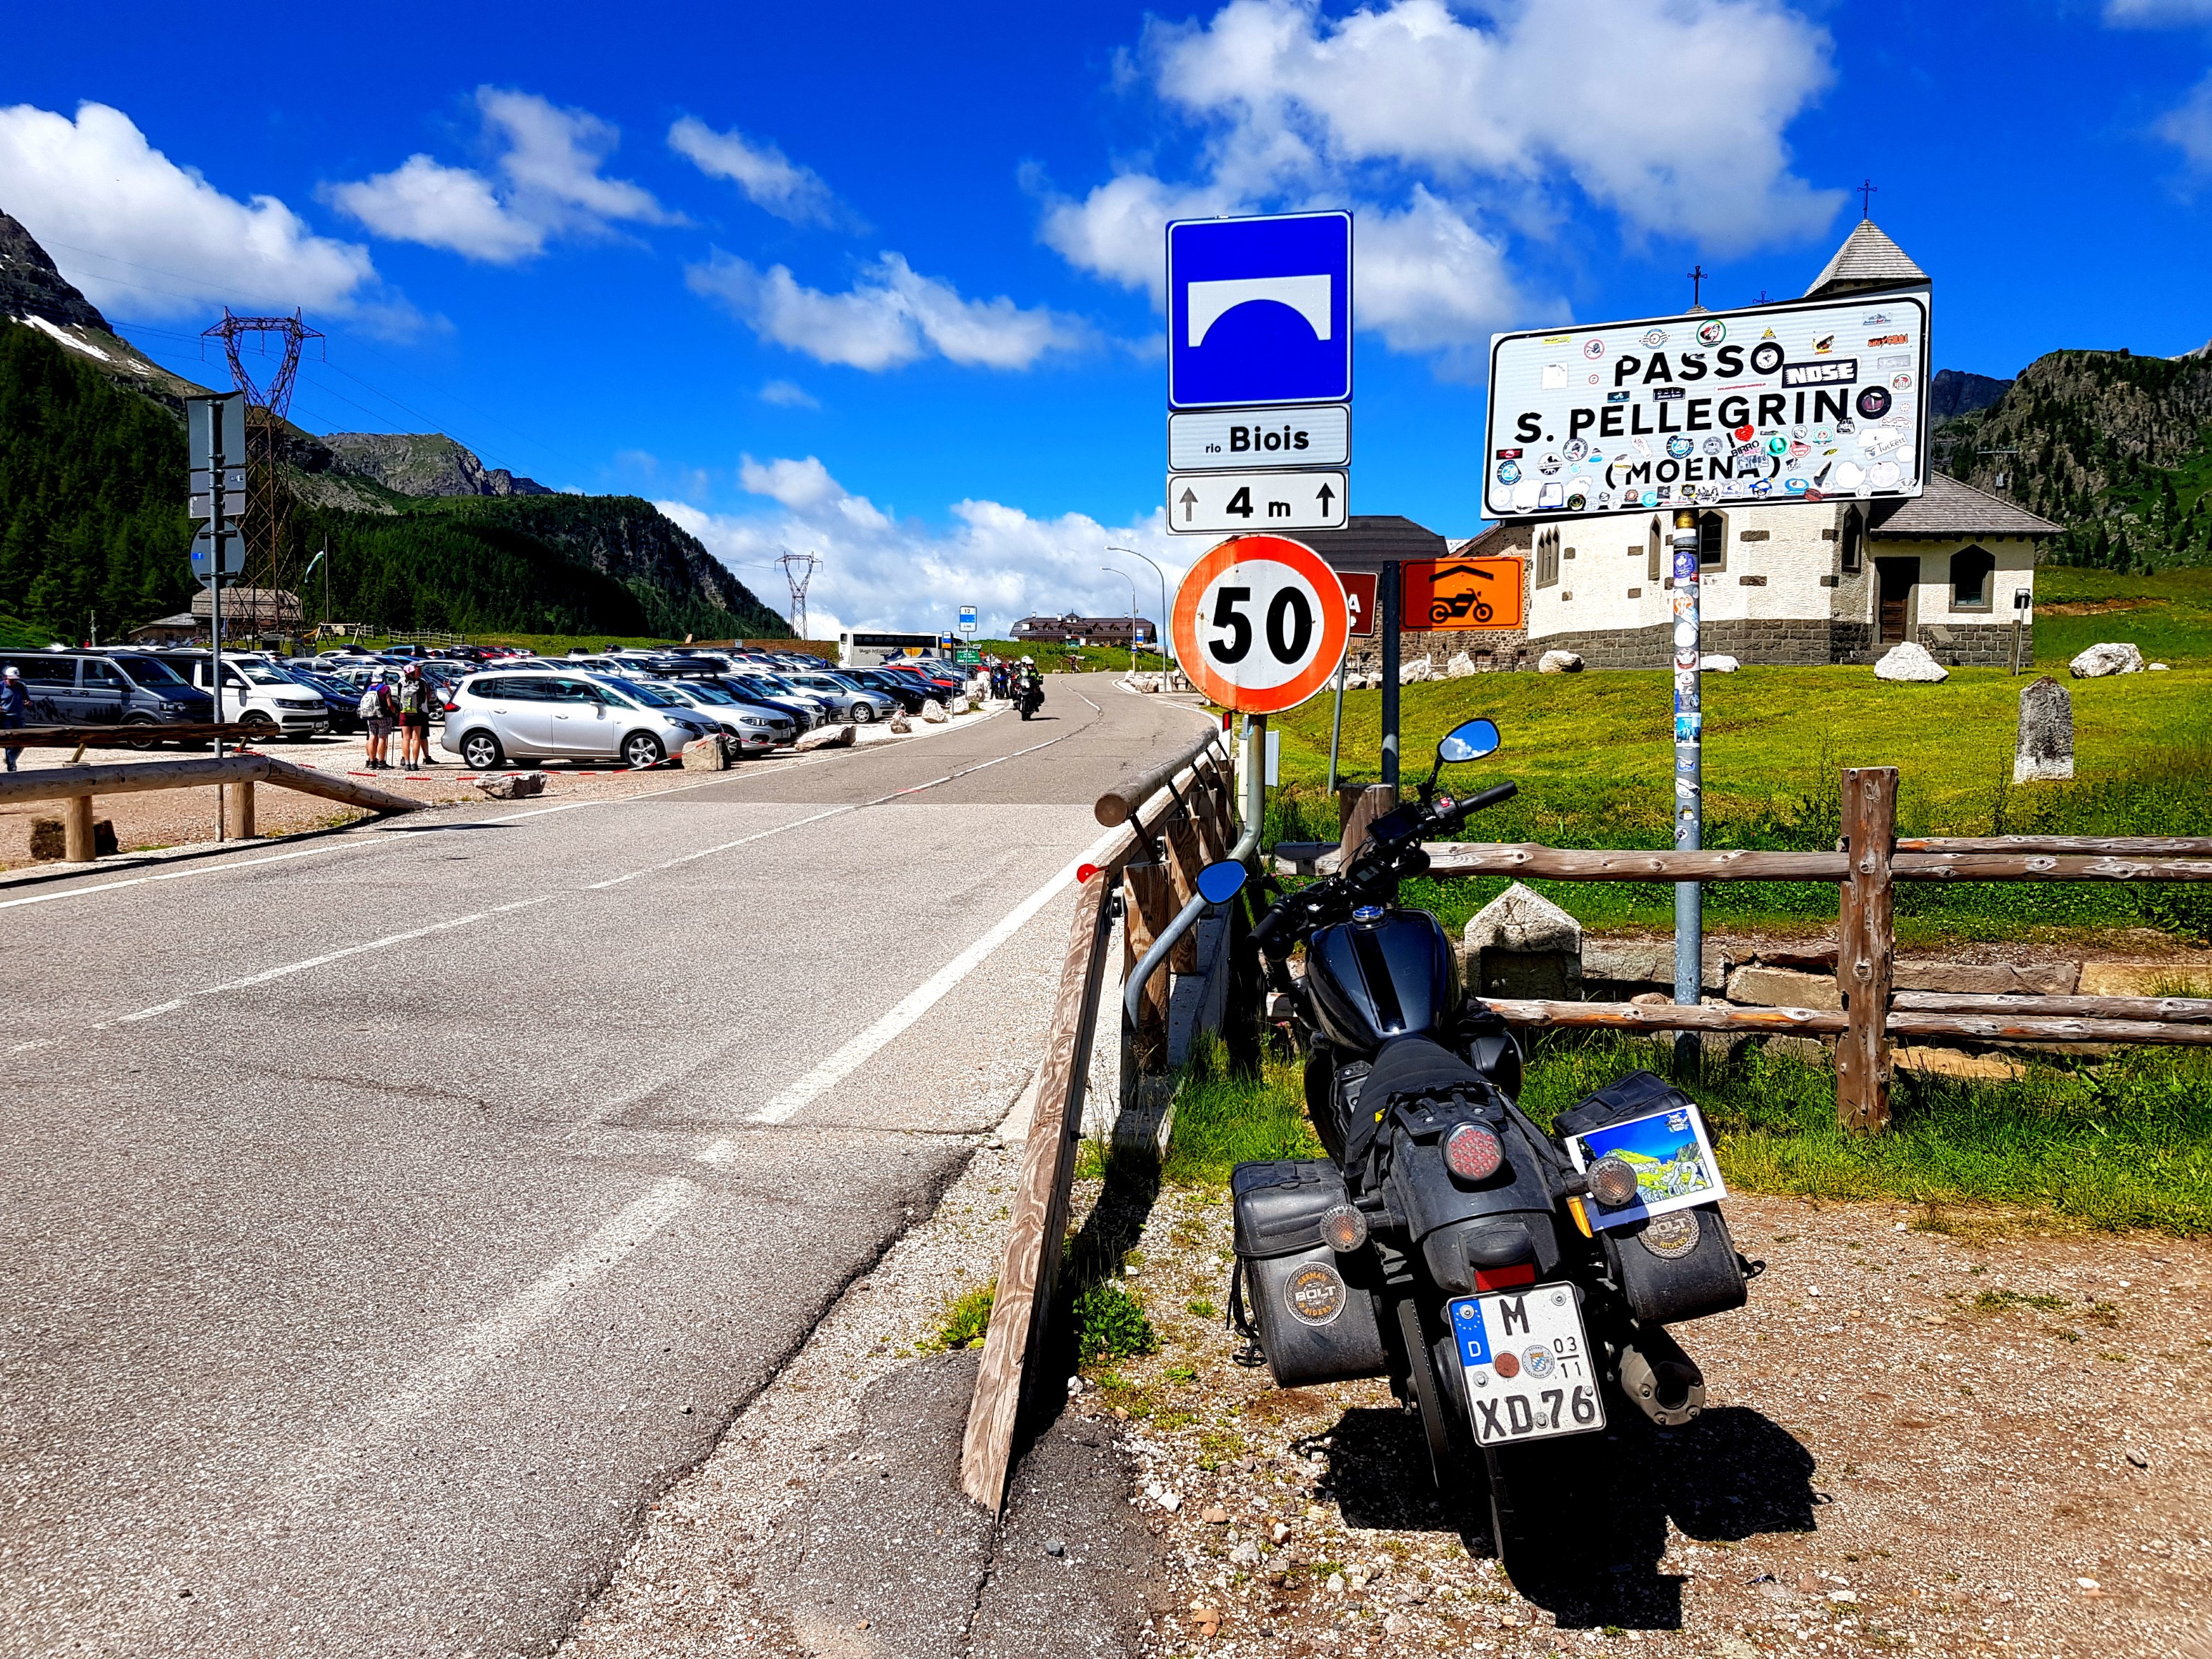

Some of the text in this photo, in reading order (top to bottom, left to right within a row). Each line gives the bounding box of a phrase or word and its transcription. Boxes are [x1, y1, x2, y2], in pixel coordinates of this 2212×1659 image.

[1615, 342, 1784, 387] PASSO
[1786, 362, 1855, 385] NOSE
[1514, 385, 1893, 444] S. PELLEGRINO
[1205, 425, 1309, 453] rio Biois
[1730, 440, 1760, 457] BIRRO
[1226, 487, 1290, 518] 4 m
[1208, 586, 1312, 664] 50
[1646, 1217, 1687, 1237] BOLT
[1658, 1236, 1688, 1249] RIDERS
[1297, 1272, 1327, 1285] GERMAN
[1295, 1285, 1336, 1302] BOLT
[1304, 1305, 1332, 1316] RIDERS
[1499, 1296, 1530, 1335] M
[1468, 1340, 1482, 1357] D
[1553, 1336, 1577, 1354] 03
[1560, 1361, 1581, 1379] 11
[1475, 1385, 1595, 1440] XD 76
